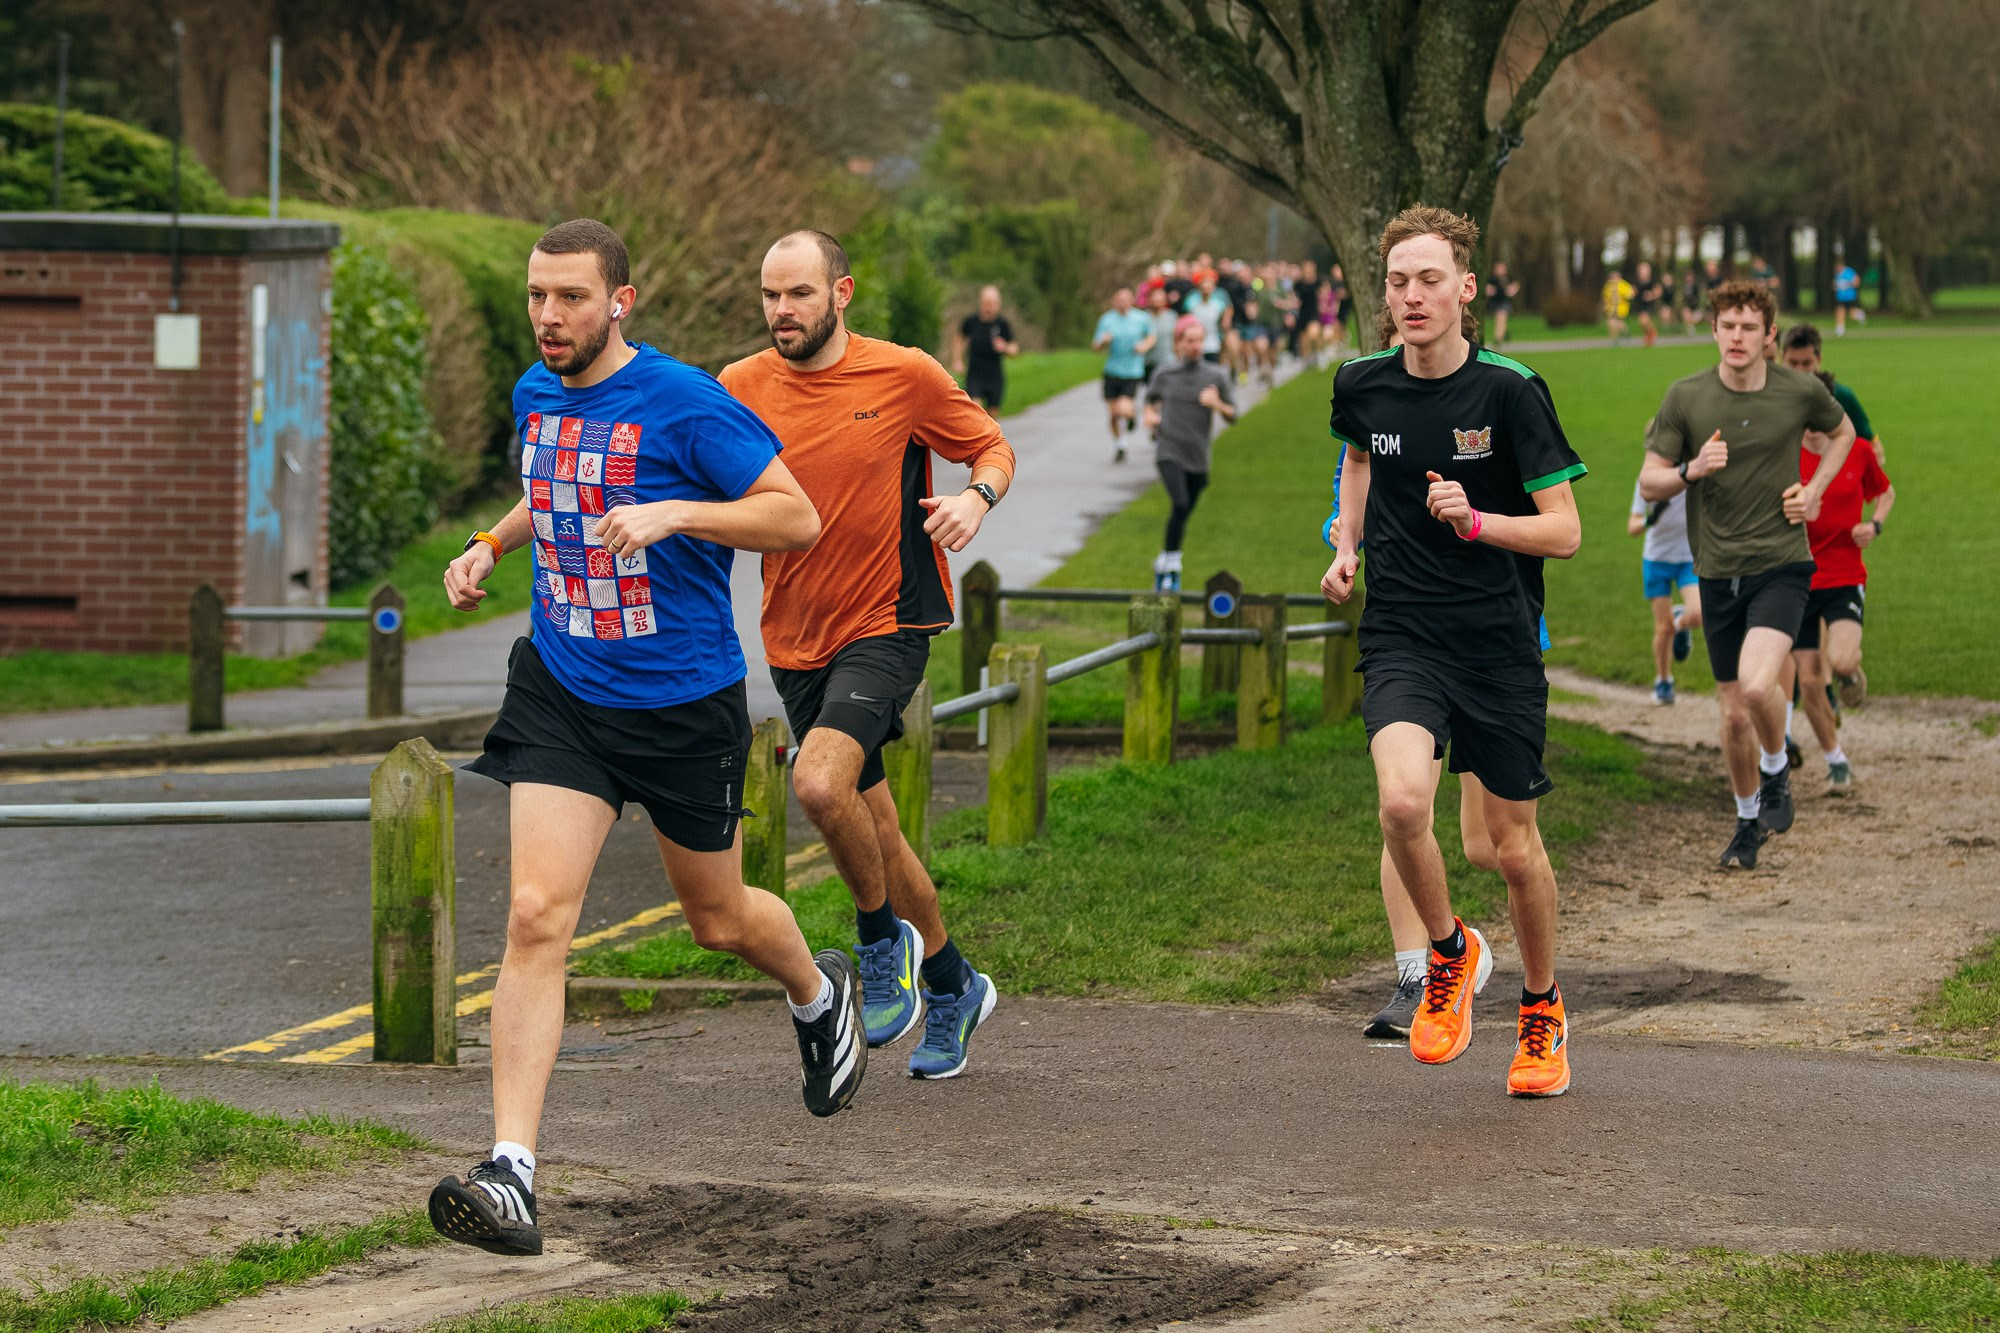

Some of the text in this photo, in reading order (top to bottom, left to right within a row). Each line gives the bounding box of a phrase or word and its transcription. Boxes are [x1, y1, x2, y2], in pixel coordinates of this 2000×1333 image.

[854, 410, 880, 420] DLX
[1371, 433, 1401, 456] FOM
[559, 518, 576, 534] 35
[631, 609, 647, 622] 20
[634, 620, 649, 632] 25
